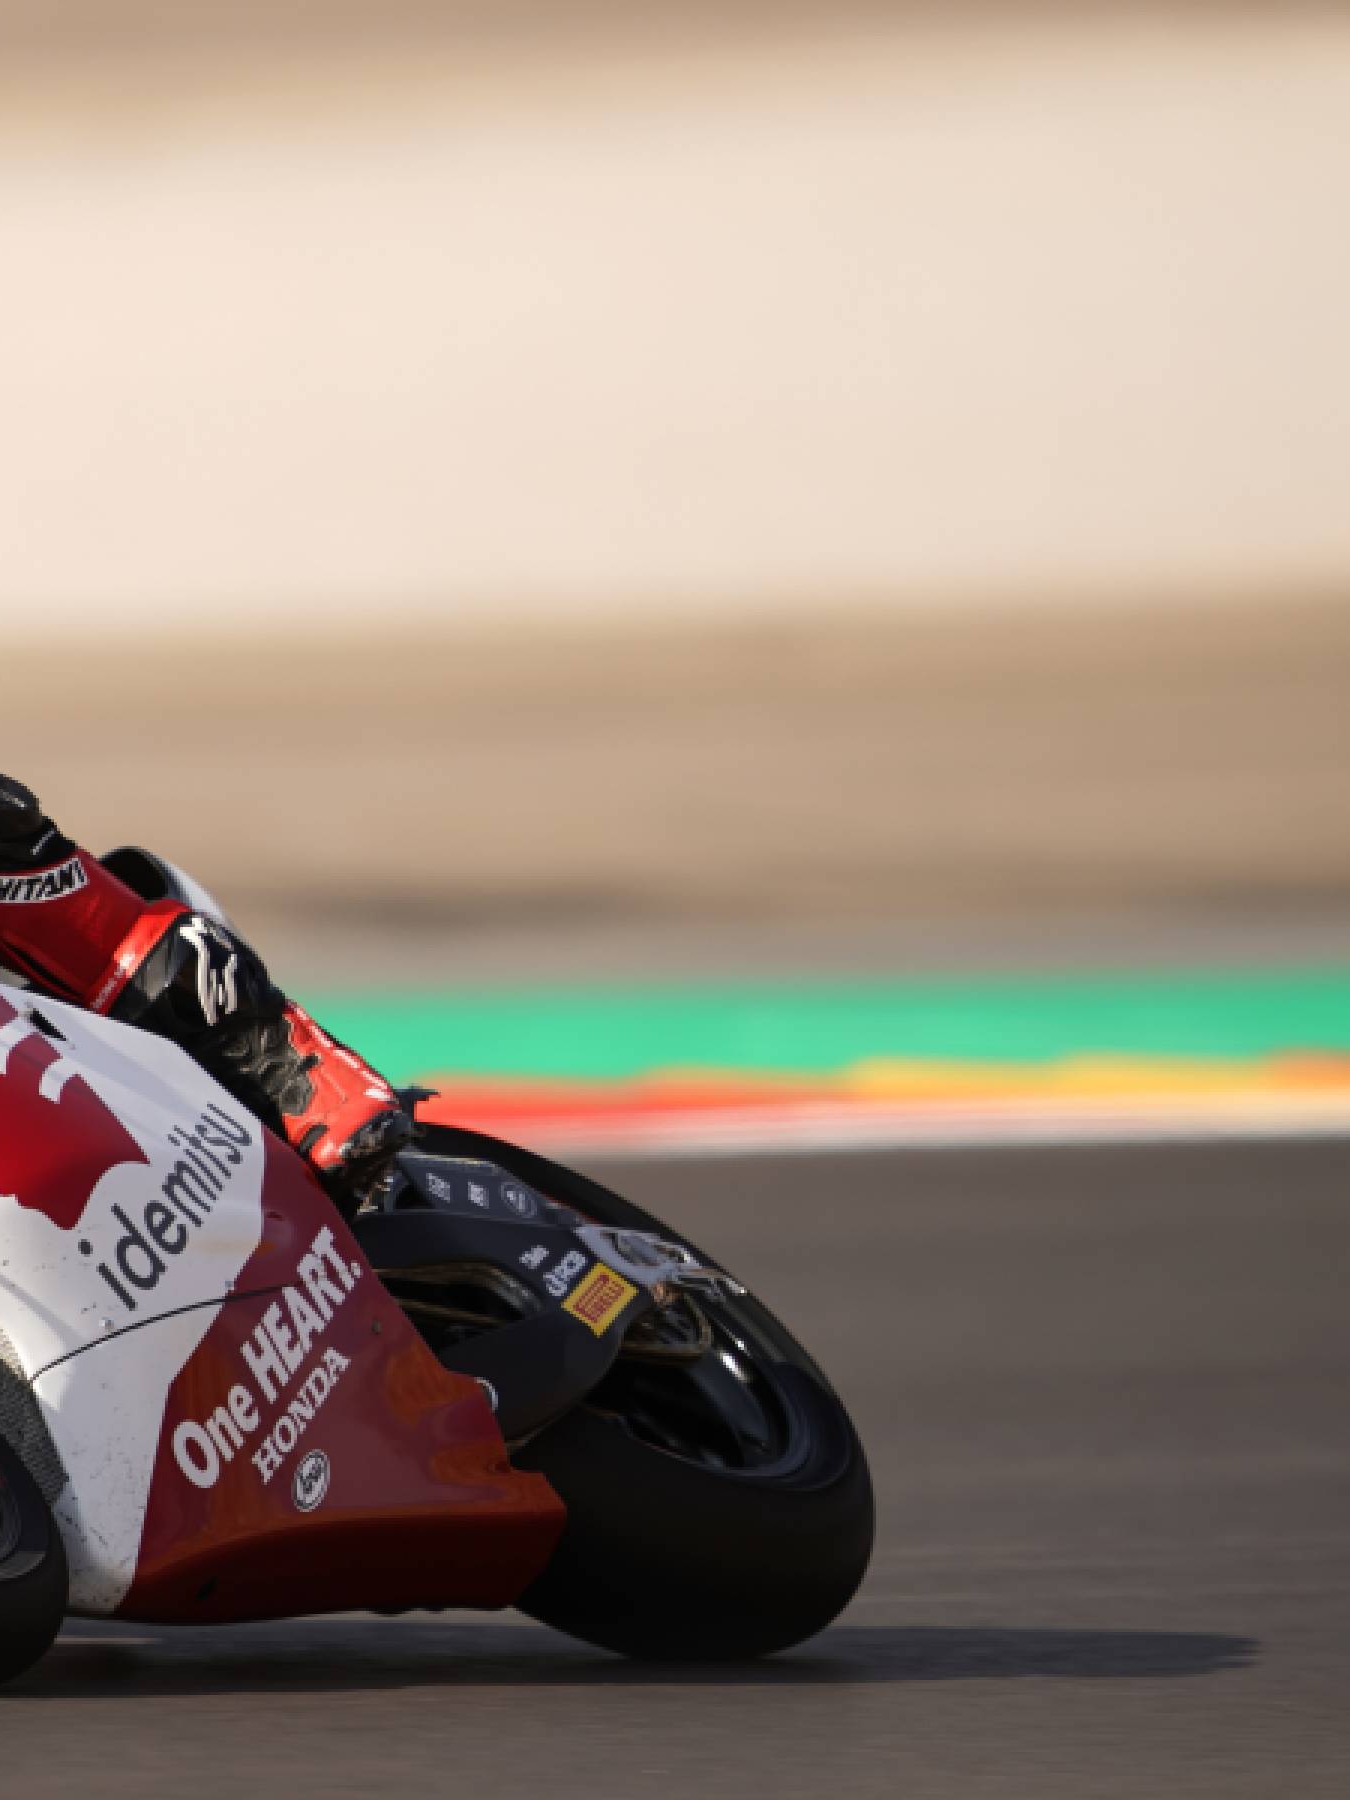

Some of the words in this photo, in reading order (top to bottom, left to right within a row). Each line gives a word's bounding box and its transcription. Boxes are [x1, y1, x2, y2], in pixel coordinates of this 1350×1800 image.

[77, 1102, 252, 1311] idemitsu
[173, 1384, 261, 1488] One
[240, 1226, 363, 1404] HEART.
[252, 1347, 351, 1484] HONDA
